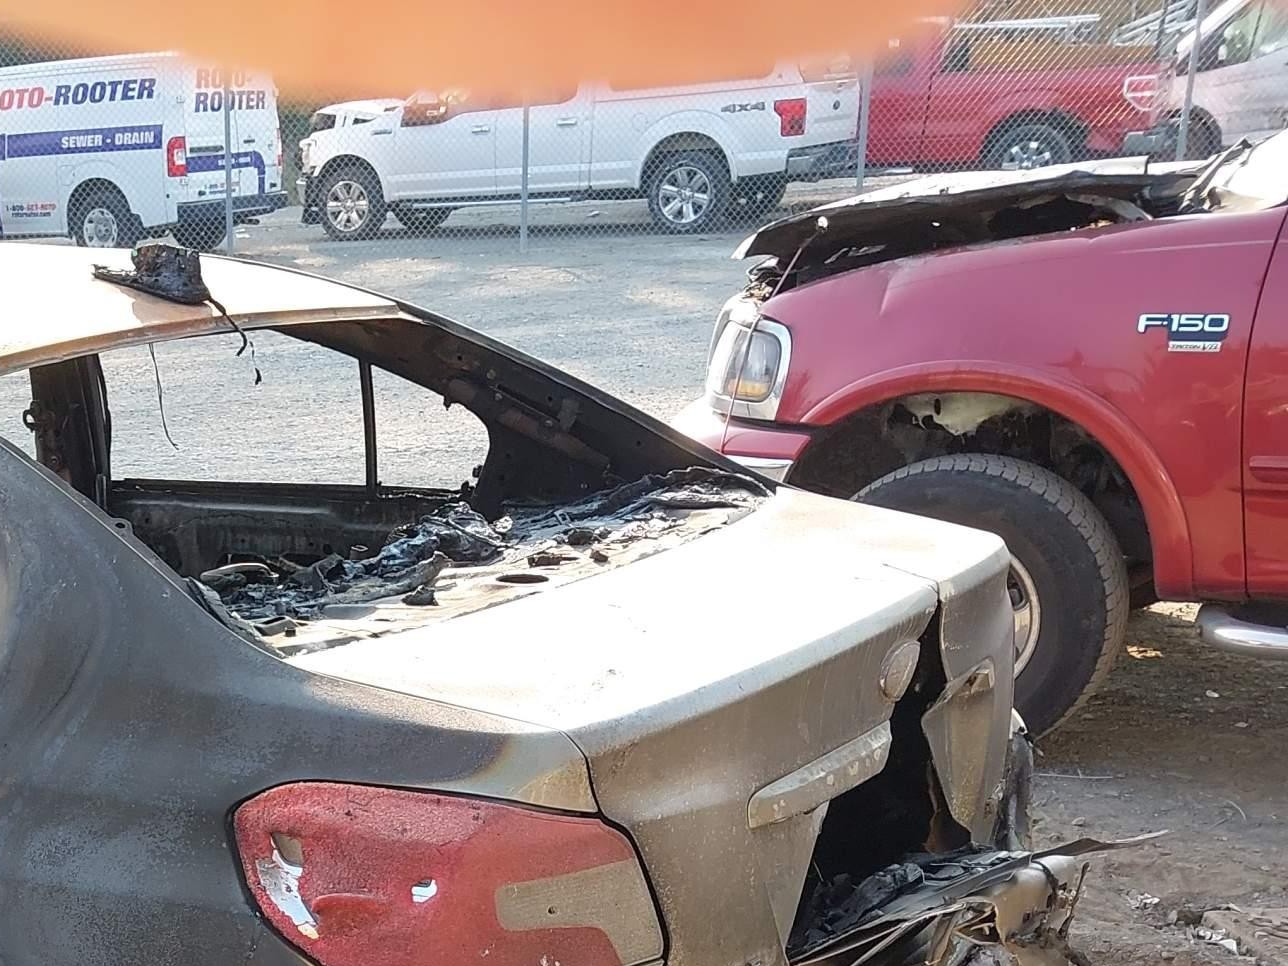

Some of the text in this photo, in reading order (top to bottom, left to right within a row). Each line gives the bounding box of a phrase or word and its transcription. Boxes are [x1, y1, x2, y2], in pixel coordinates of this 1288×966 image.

[195, 67, 250, 89] ROO-
[61, 131, 155, 149] SEWER DRAIN
